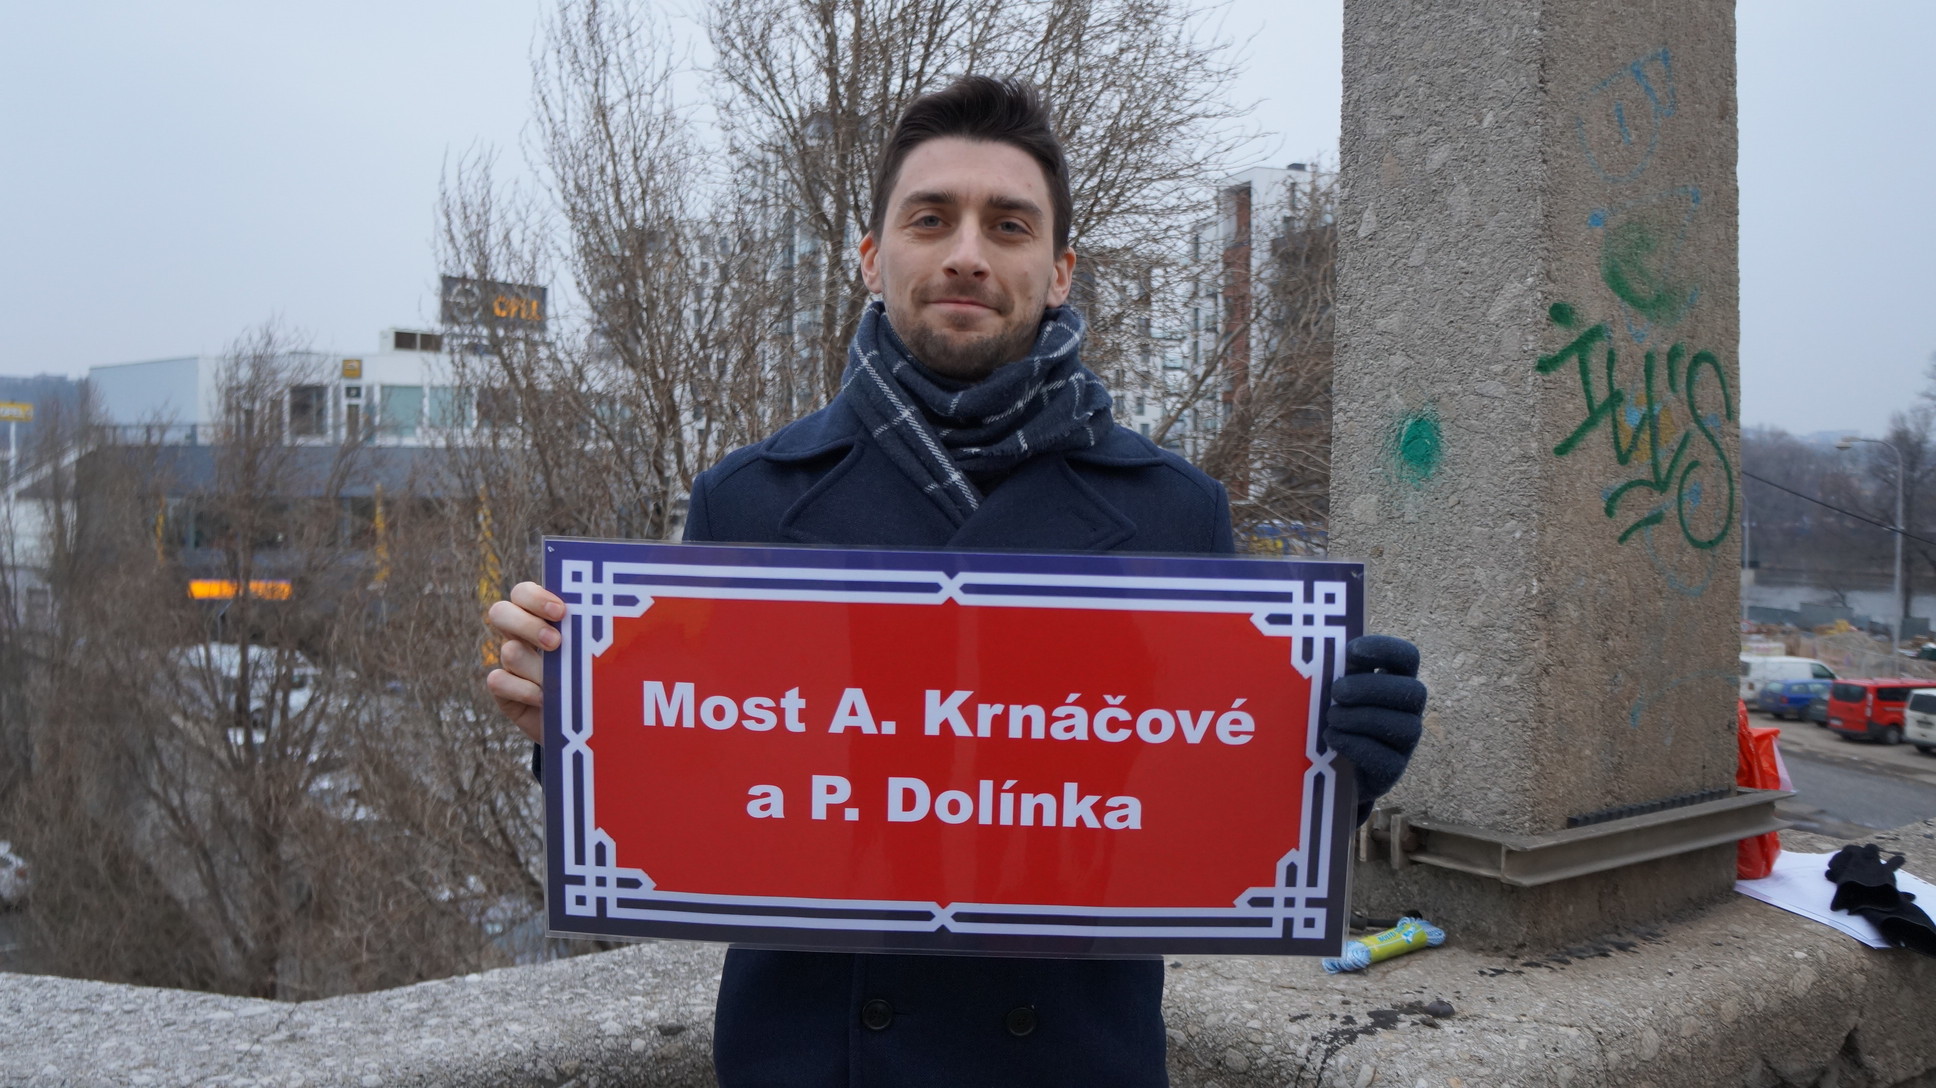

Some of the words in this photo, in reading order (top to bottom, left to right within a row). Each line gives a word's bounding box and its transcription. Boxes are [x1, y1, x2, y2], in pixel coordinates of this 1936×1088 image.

[643, 680, 806, 733] Most
[828, 687, 896, 735] A.
[924, 688, 1255, 746] Krnáčové
[746, 784, 785, 819] a
[811, 774, 859, 821] P.
[887, 777, 1142, 831] Dolínka
